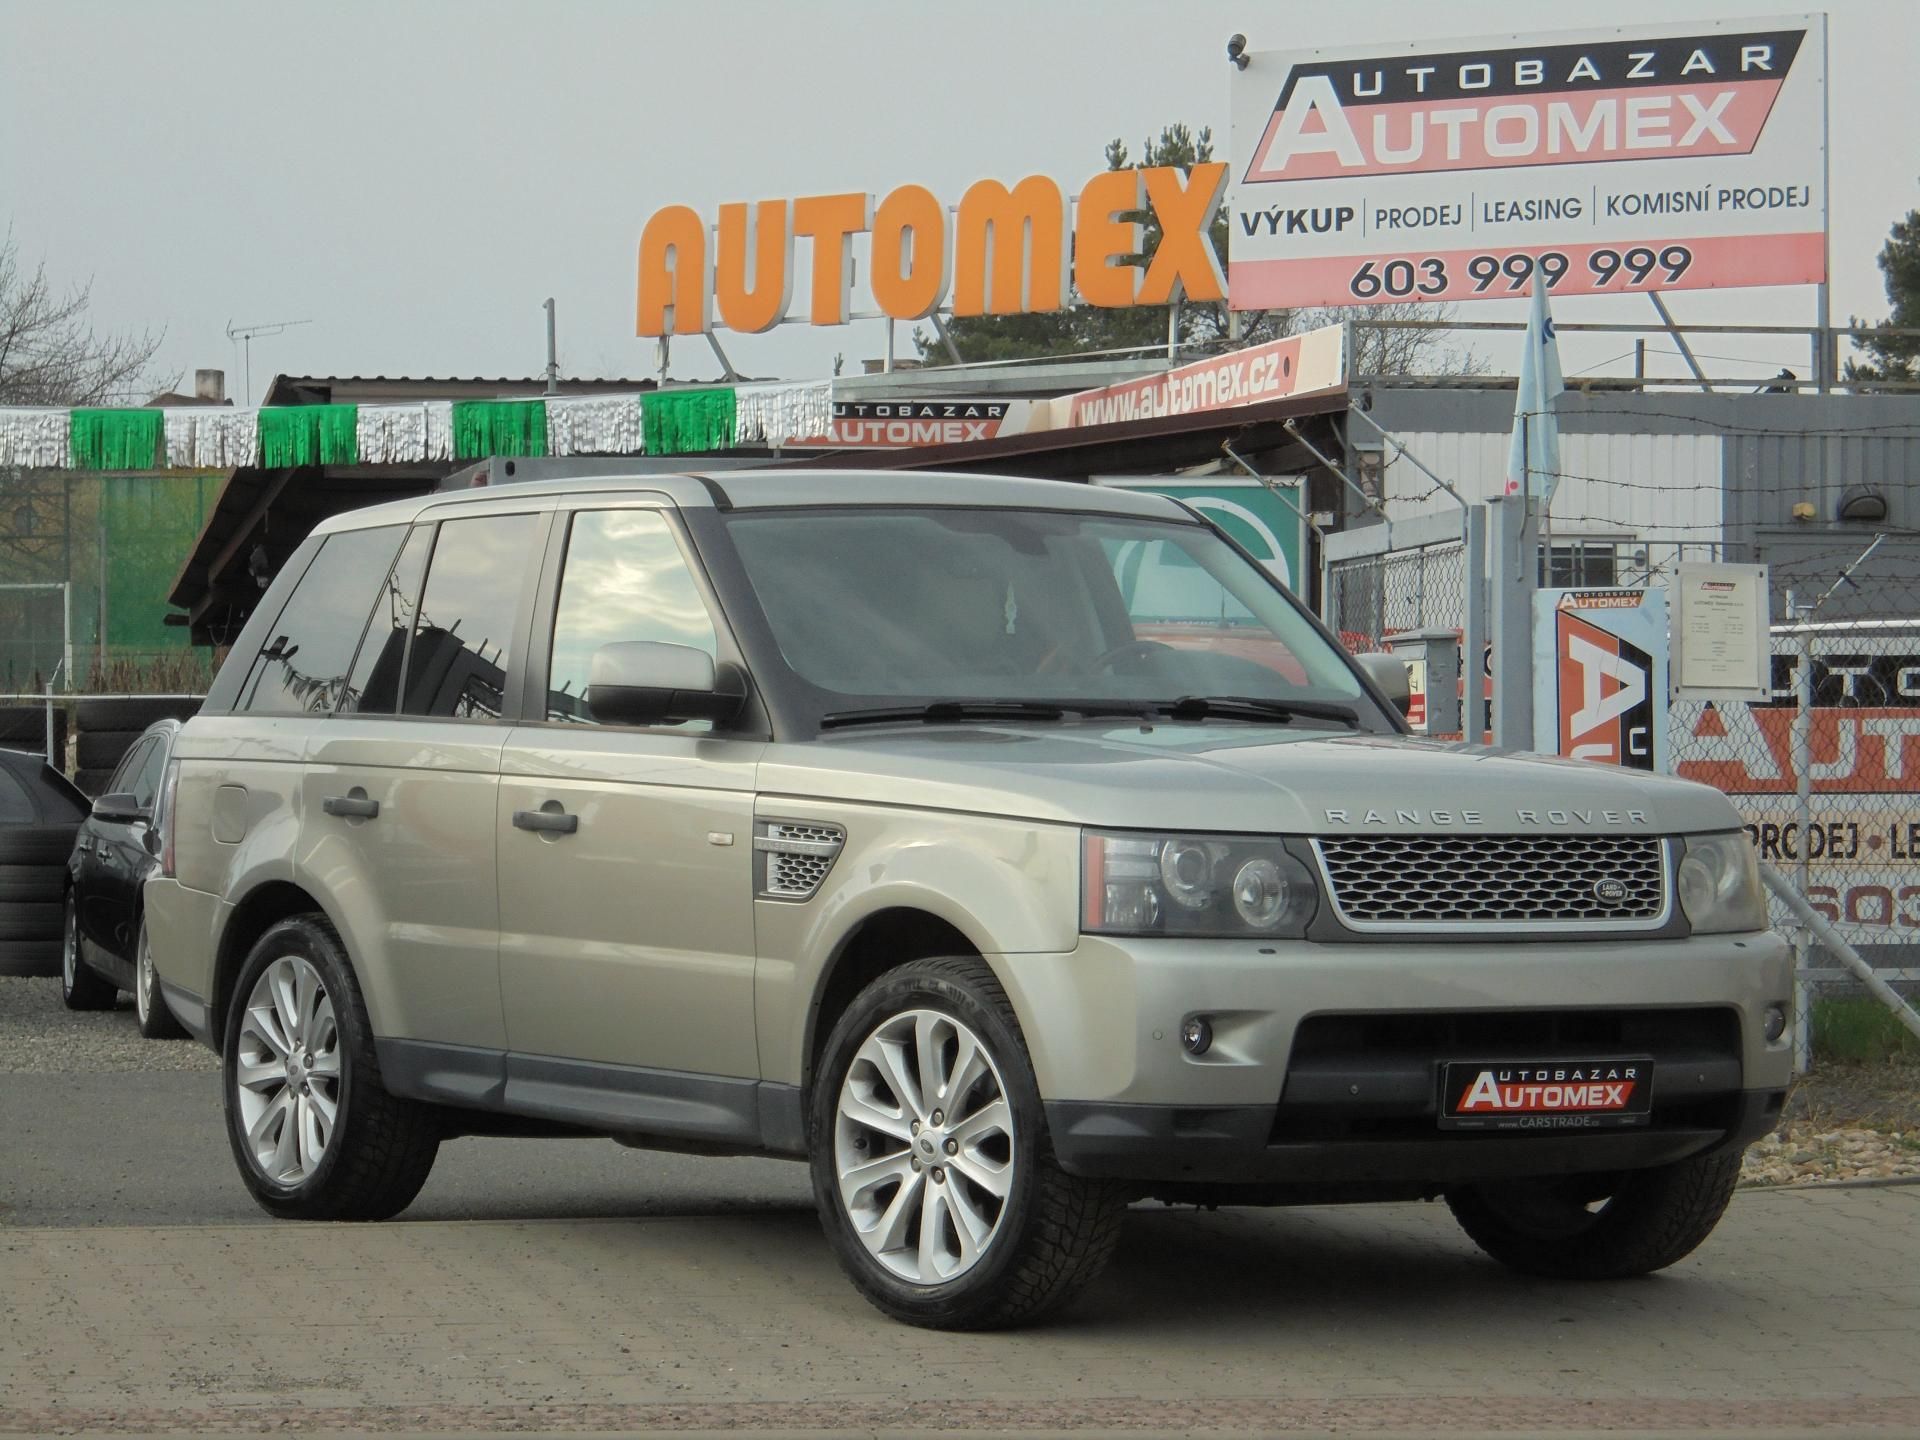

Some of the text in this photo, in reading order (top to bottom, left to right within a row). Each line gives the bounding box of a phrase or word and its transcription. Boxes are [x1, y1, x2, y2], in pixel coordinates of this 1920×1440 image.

[1259, 75, 1738, 172] AUTOMEX
[1239, 185, 1811, 237] VÝKUP PRODEJ LEASING KOMISNÍ PRODEJ
[636, 162, 1229, 337] AUTOMEX
[1350, 245, 1692, 299] 603 999 999
[1081, 352, 1279, 428] www.automex.cz
[1559, 592, 1638, 610] AUTOMEX
[1325, 808, 1648, 825] RANGE ROVER
[1464, 1071, 1624, 1108] AUTOMEX
